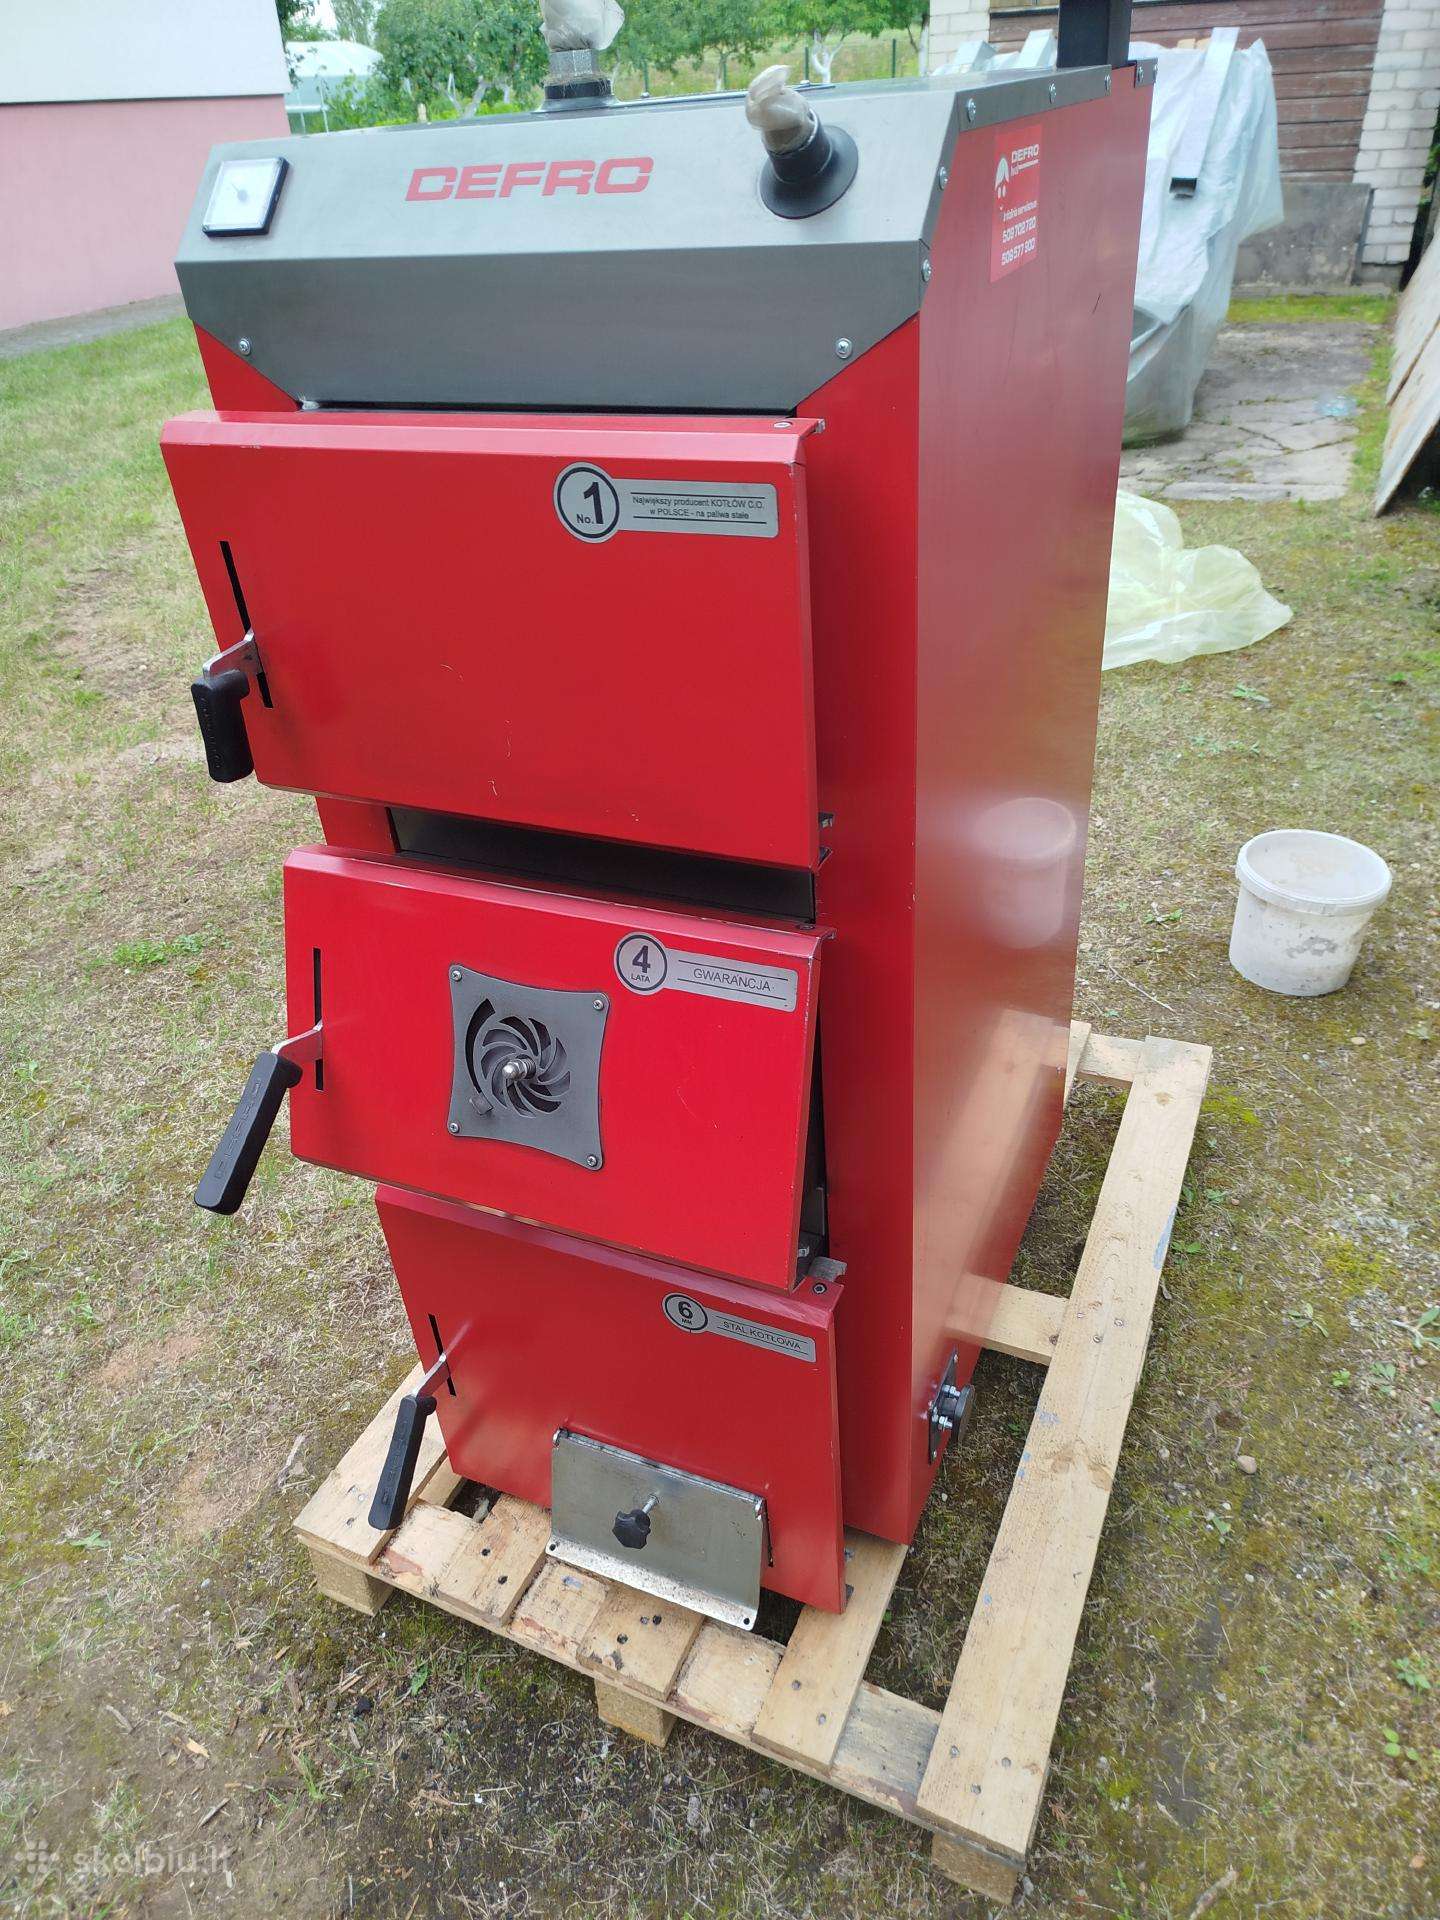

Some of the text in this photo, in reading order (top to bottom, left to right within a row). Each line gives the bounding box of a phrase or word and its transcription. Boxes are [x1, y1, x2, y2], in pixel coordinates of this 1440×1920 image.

[1011, 144, 1039, 163] DEFRO
[405, 157, 654, 201] DEFRO
[583, 481, 604, 525] 1
[657, 508, 690, 516] POLSCE
[707, 511, 731, 519] paliwa
[632, 945, 651, 974] 4
[630, 973, 651, 984] LATA
[693, 968, 771, 992] GWARANCJA
[677, 1301, 694, 1320] 6
[723, 1321, 747, 1334] STAL
